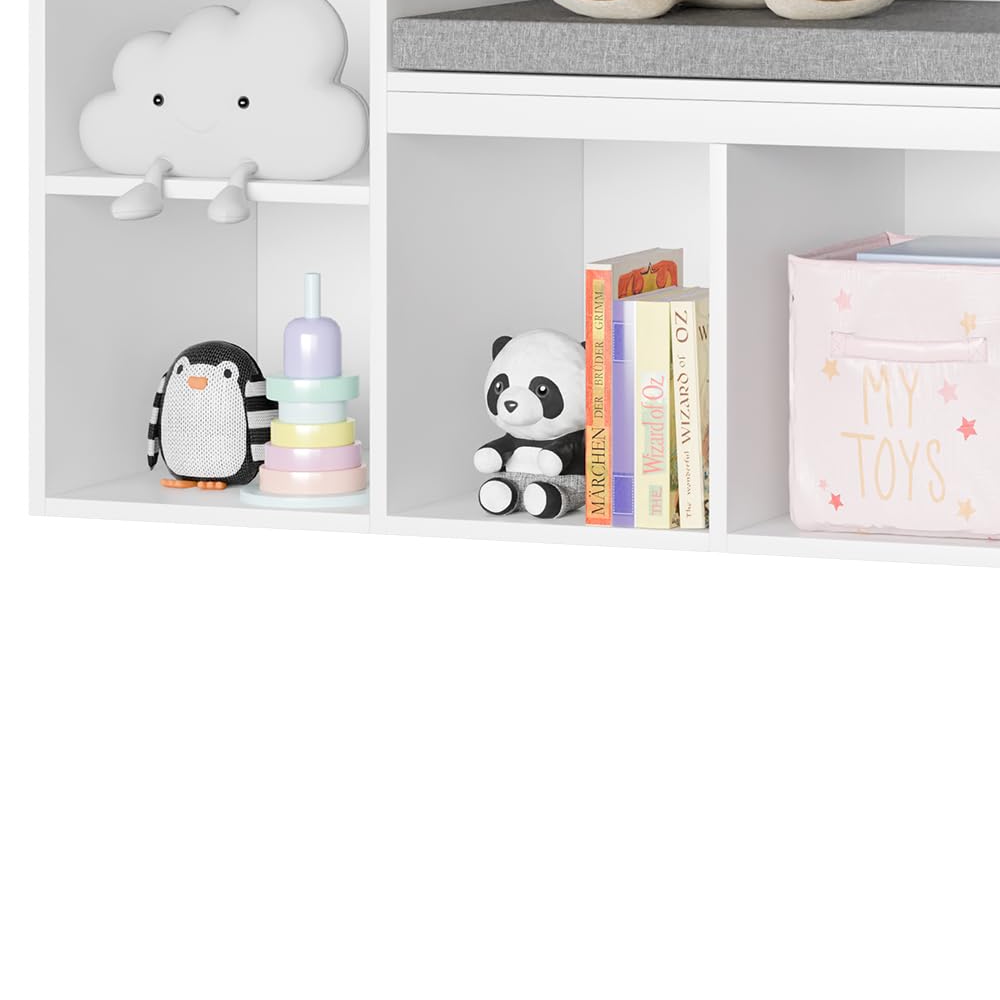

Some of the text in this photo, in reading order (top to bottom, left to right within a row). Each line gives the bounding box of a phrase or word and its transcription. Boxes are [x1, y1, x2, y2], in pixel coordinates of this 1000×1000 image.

[594, 290, 604, 330] GRIMM
[674, 310, 689, 343] OZ
[677, 354, 686, 368] of
[594, 396, 604, 419] DER
[677, 372, 691, 444] WIZARD
[862, 364, 919, 428] MY
[588, 427, 606, 516] MÄRCHEN
[641, 375, 665, 516] THE Wizard of Oz
[840, 431, 946, 503] TOYS
